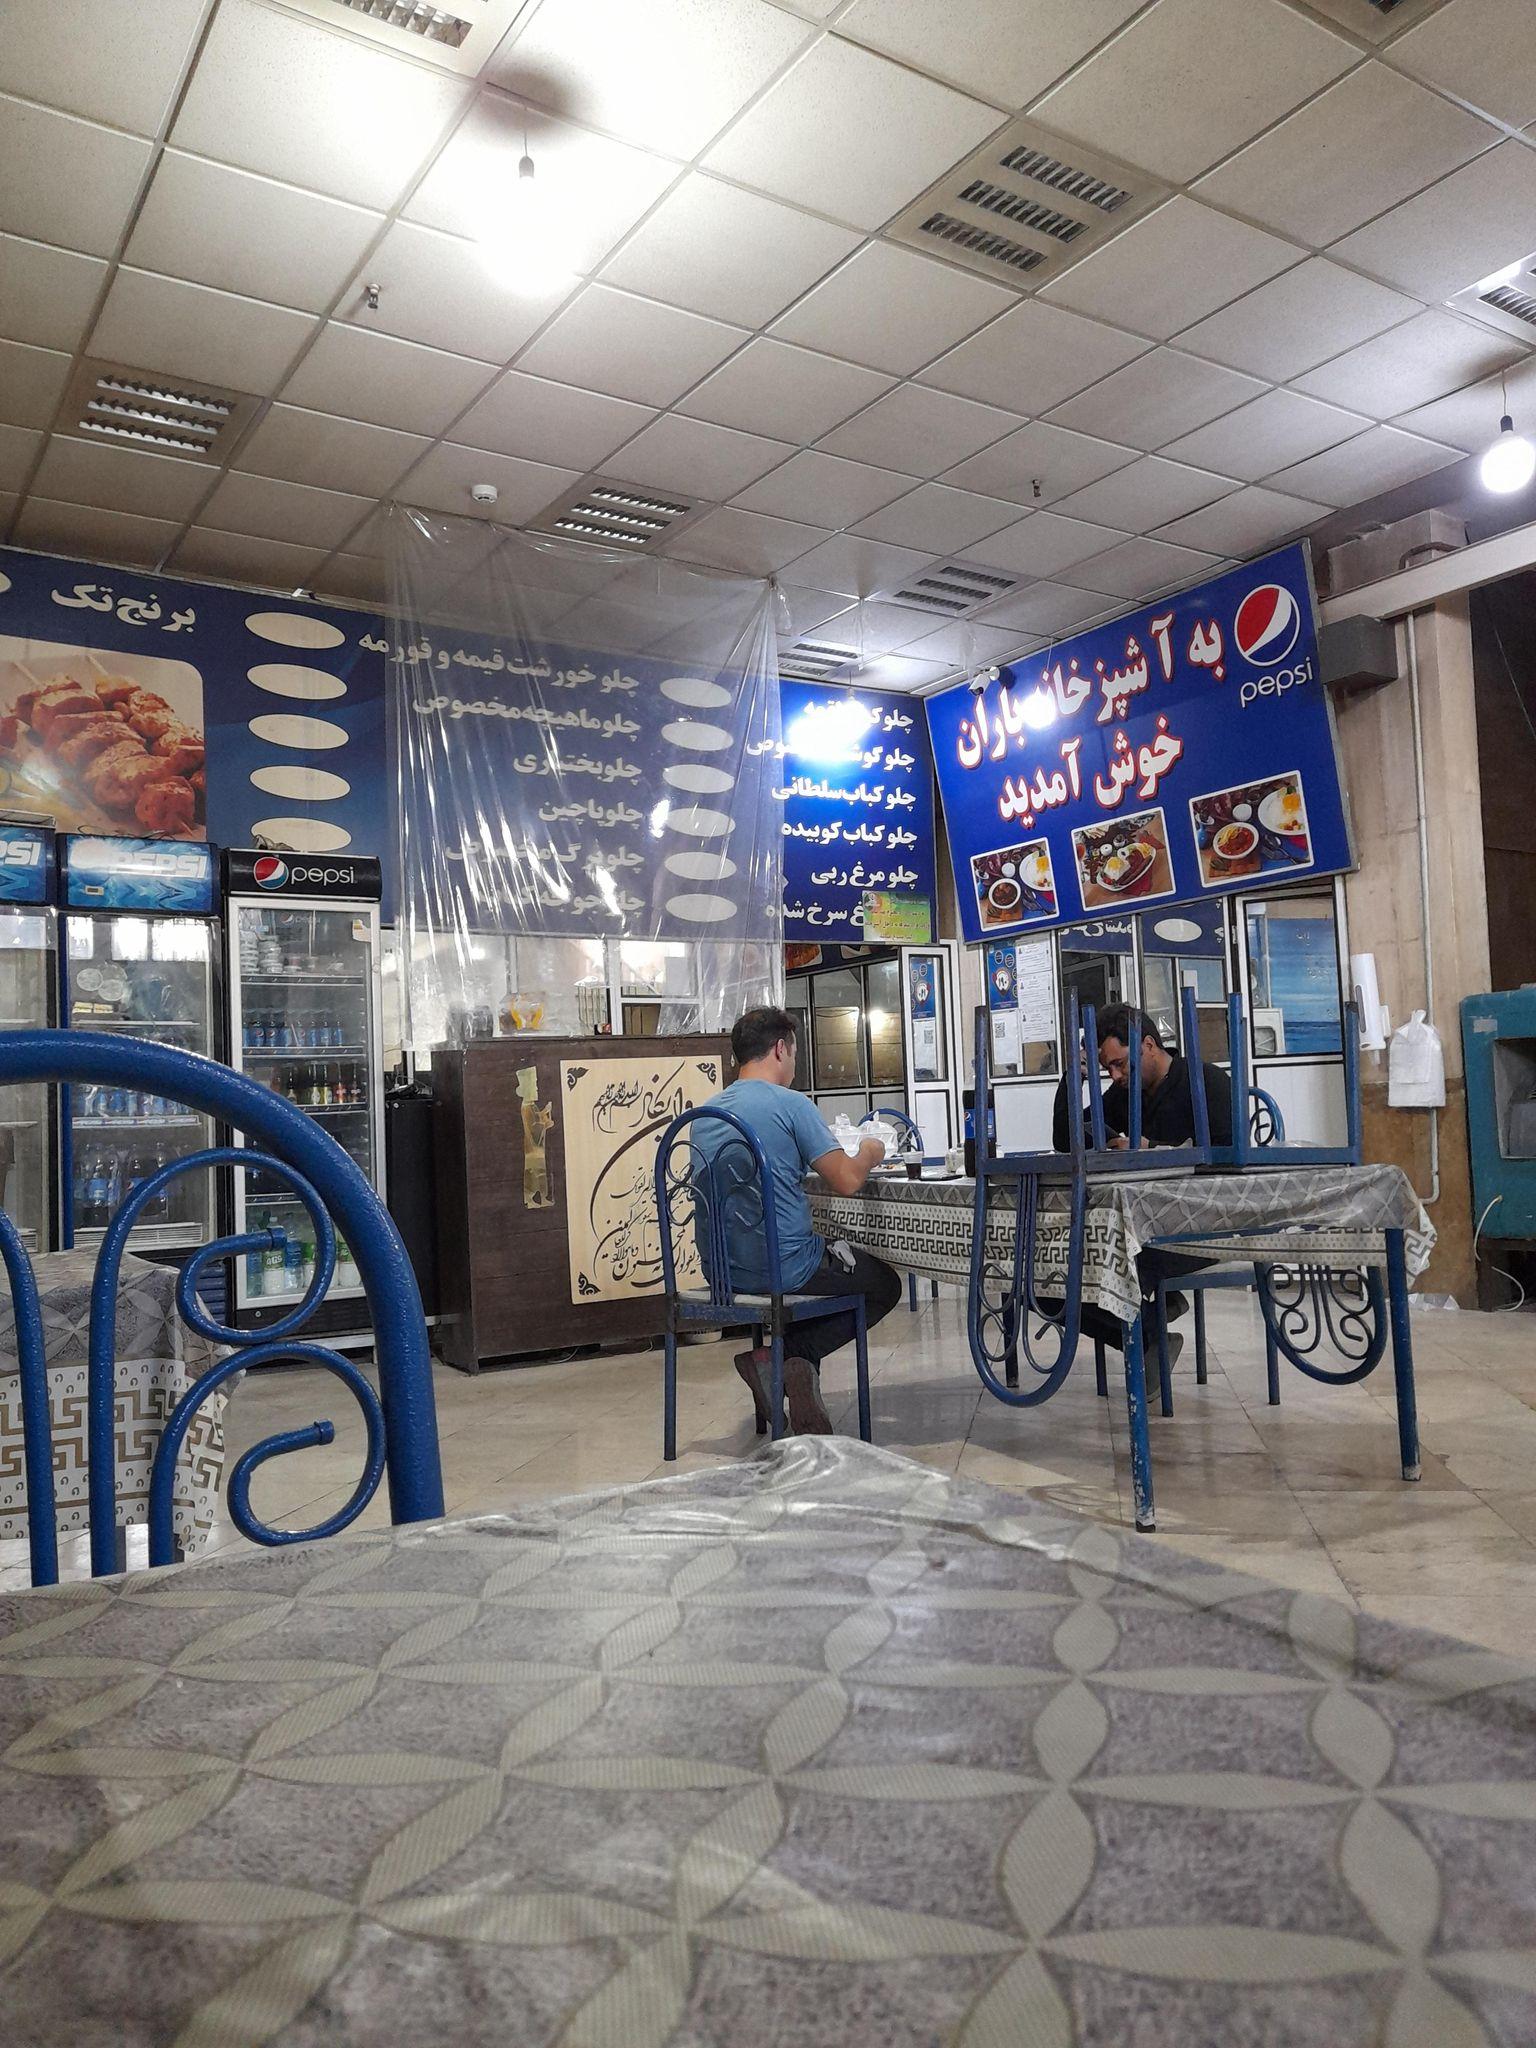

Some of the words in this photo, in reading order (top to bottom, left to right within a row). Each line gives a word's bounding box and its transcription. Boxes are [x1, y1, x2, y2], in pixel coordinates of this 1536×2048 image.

[1188, 619, 1224, 680] به
[1027, 611, 1175, 723] آشپزخان
[600, 668, 640, 697] چلو
[1239, 657, 1314, 708] pepsi
[882, 708, 914, 733] چلو
[957, 685, 1026, 770] باران
[884, 748, 915, 773] چلو
[1094, 713, 1183, 809] خوش
[771, 776, 843, 801] سلطانی
[843, 783, 885, 807] کباب
[998, 737, 1082, 829] آمدید
[885, 786, 917, 811] چلو
[780, 821, 842, 844] کوبیده
[843, 824, 886, 845] کباب
[886, 826, 918, 850] چلو
[291, 866, 356, 887] pepsi
[850, 861, 885, 888] مرغ
[886, 865, 918, 890] چلو
[807, 902, 847, 927] سرخ
